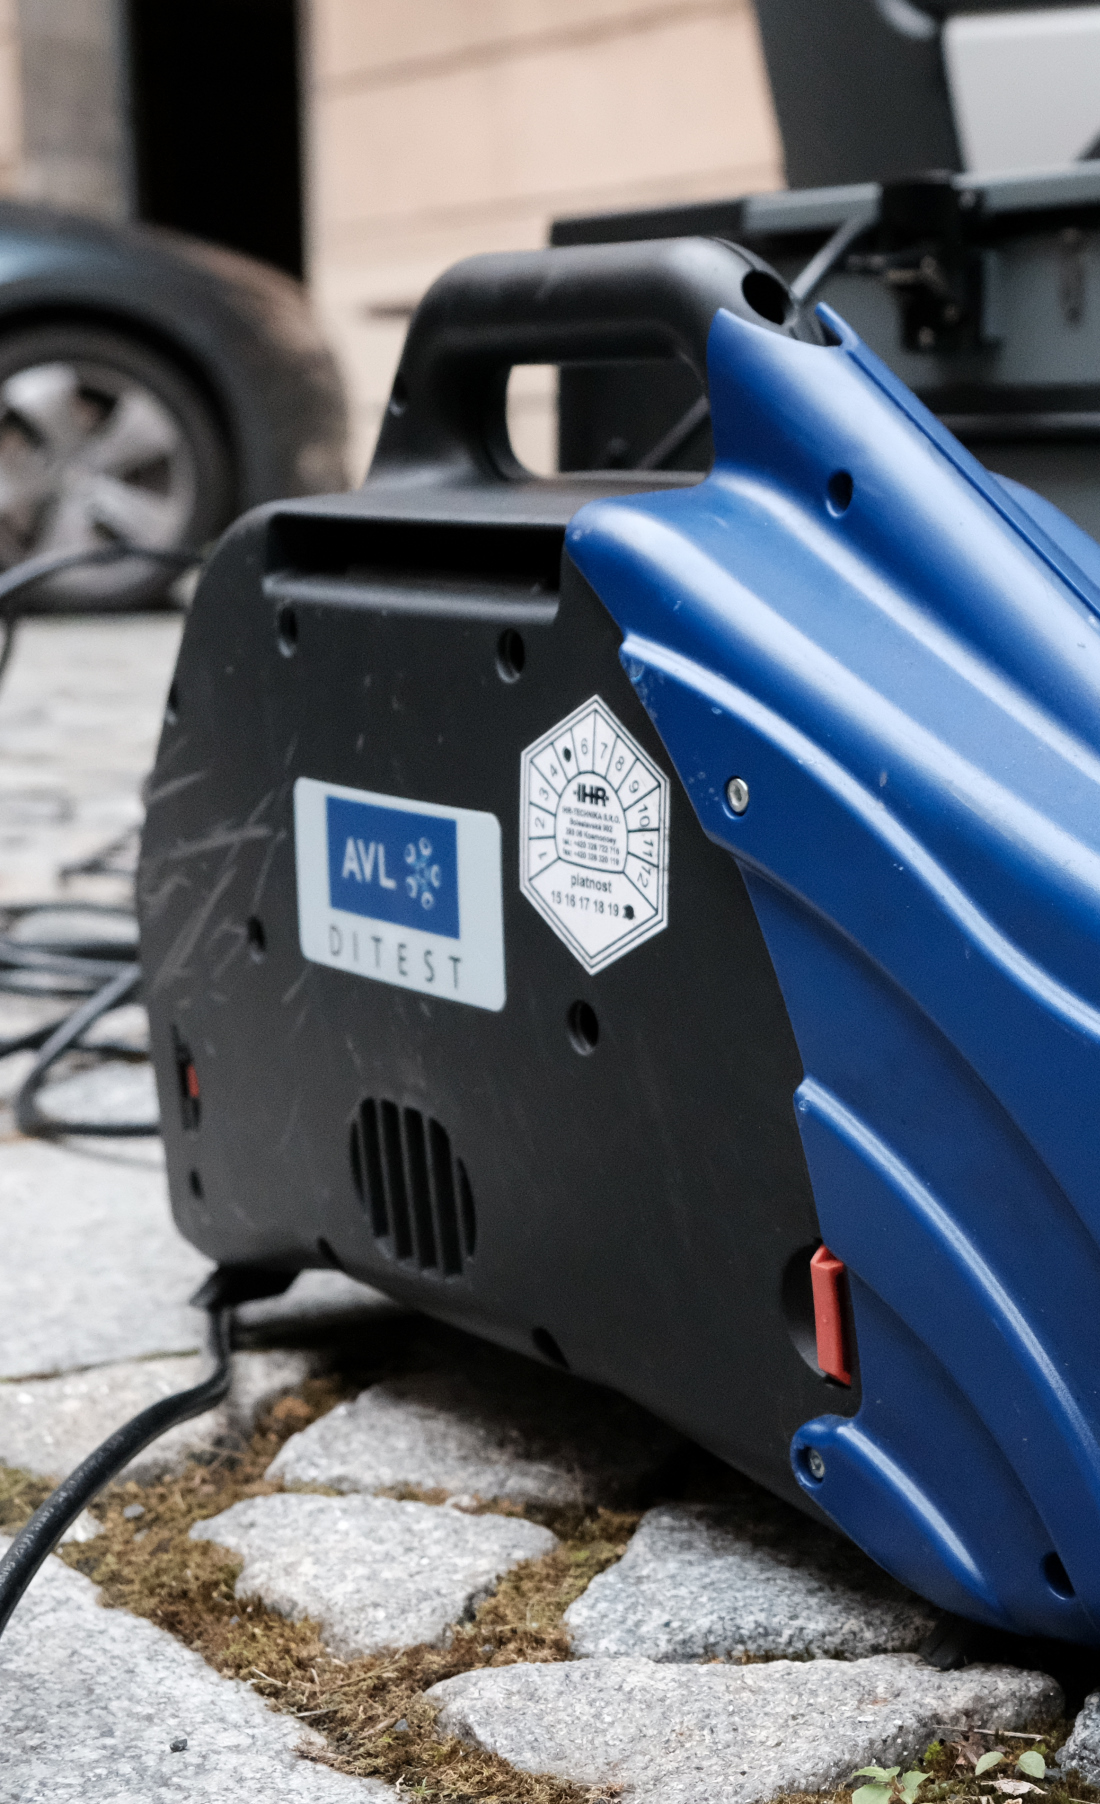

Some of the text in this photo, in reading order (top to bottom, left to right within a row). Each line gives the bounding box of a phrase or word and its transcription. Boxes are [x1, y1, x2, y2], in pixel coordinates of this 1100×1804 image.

[581, 738, 588, 755] 6
[600, 742, 608, 760] 7
[550, 764, 558, 778] 4
[615, 756, 624, 772] 8
[540, 788, 550, 802] 3
[629, 780, 639, 794] 9
[536, 817, 545, 829] 2
[637, 805, 650, 828] 10
[642, 839, 654, 858] 11
[342, 836, 397, 890] AVL
[570, 873, 612, 893] platnost
[637, 865, 651, 888] 12
[551, 890, 561, 904] 15
[565, 893, 575, 908] 16
[579, 896, 589, 910] 17
[594, 899, 604, 914] 18
[608, 902, 619, 917] 19
[328, 924, 462, 991] DITEST
